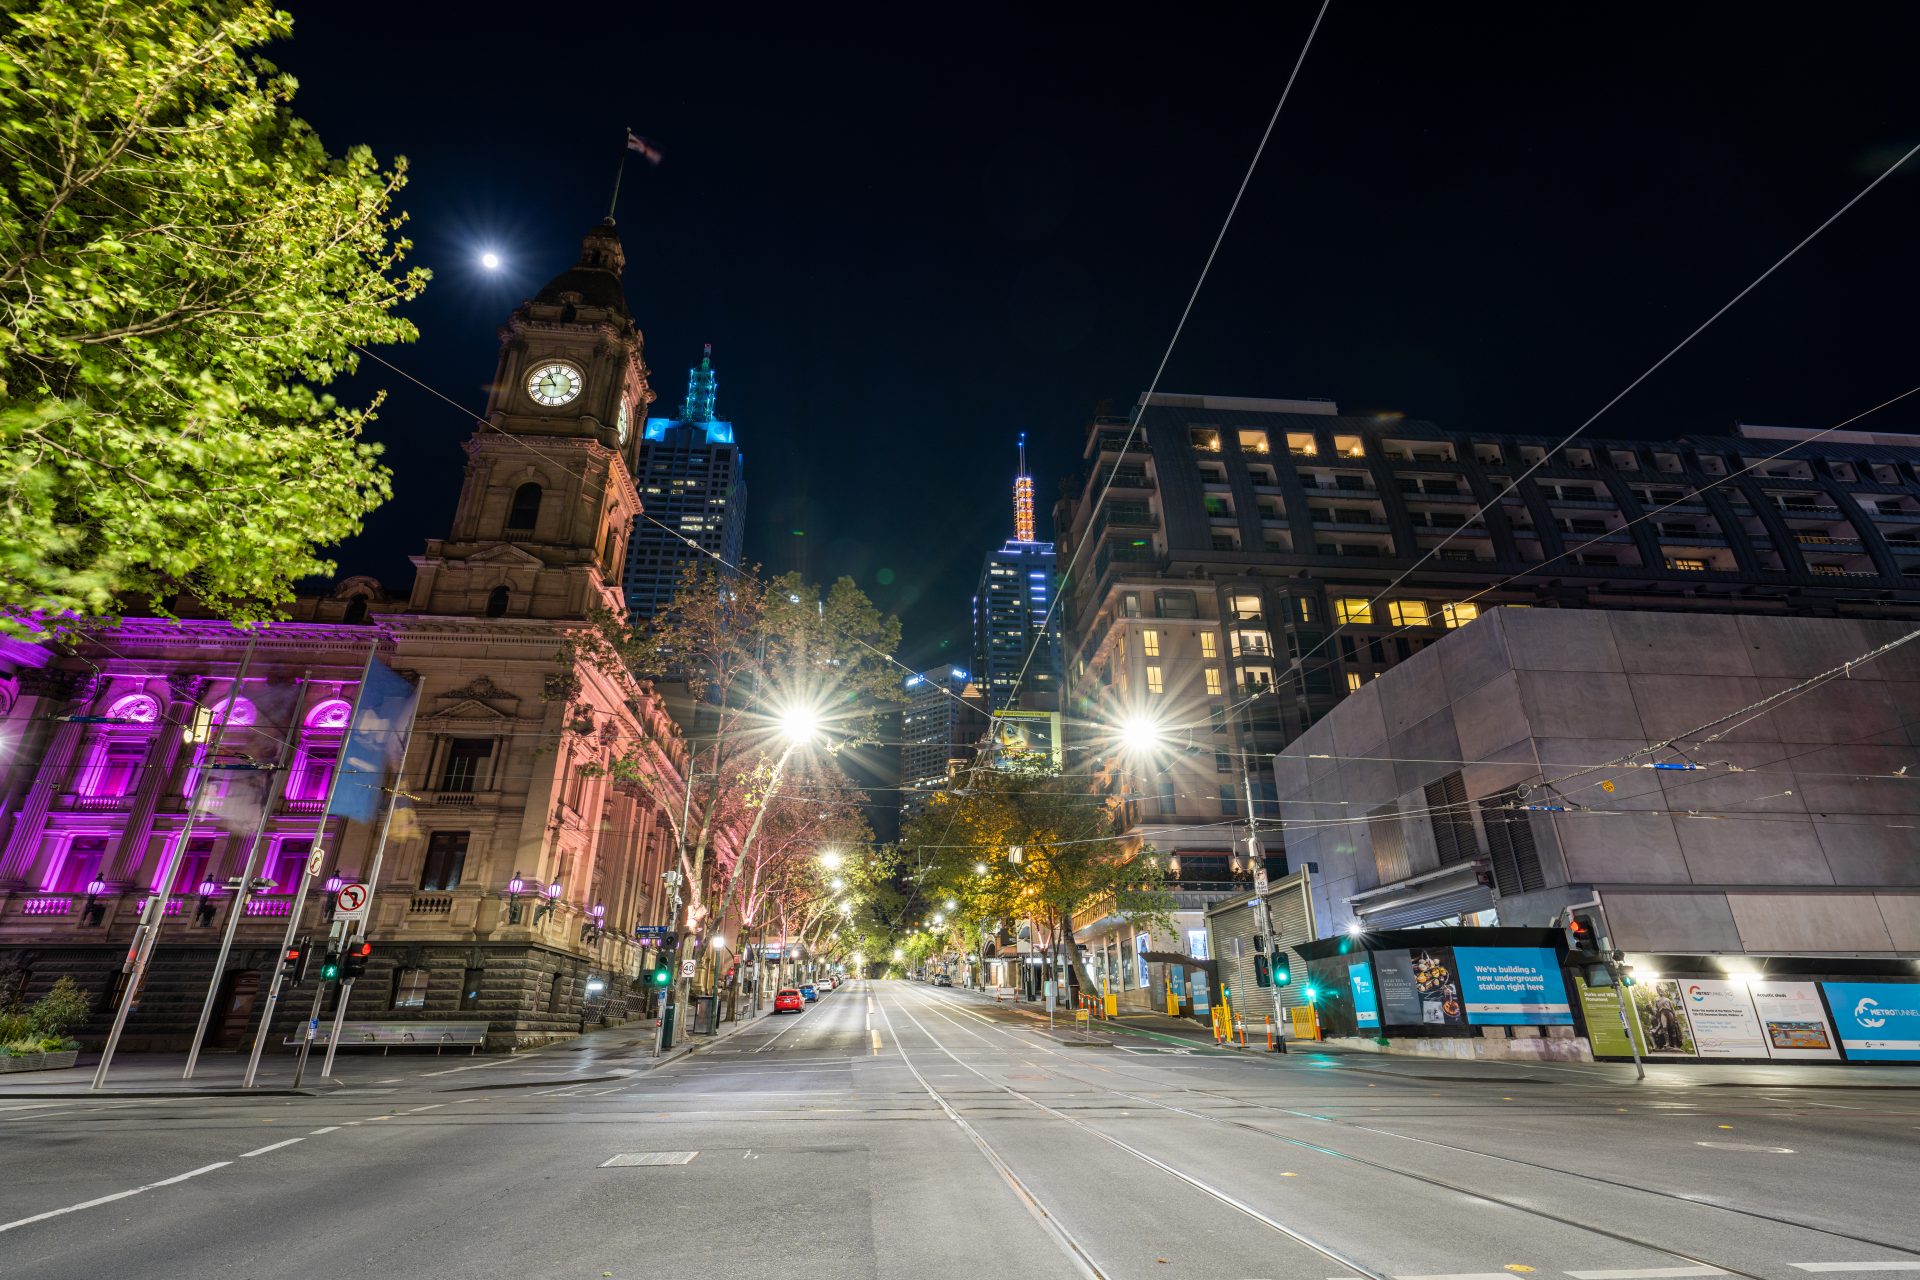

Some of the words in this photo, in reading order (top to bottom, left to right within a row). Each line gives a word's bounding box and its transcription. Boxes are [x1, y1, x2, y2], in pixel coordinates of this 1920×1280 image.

[1474, 965, 1497, 974] We're
[1499, 965, 1530, 975] building
[1494, 974, 1544, 984] underground
[1478, 983, 1506, 991] station
[1507, 983, 1526, 992] right
[1527, 983, 1545, 991] here
